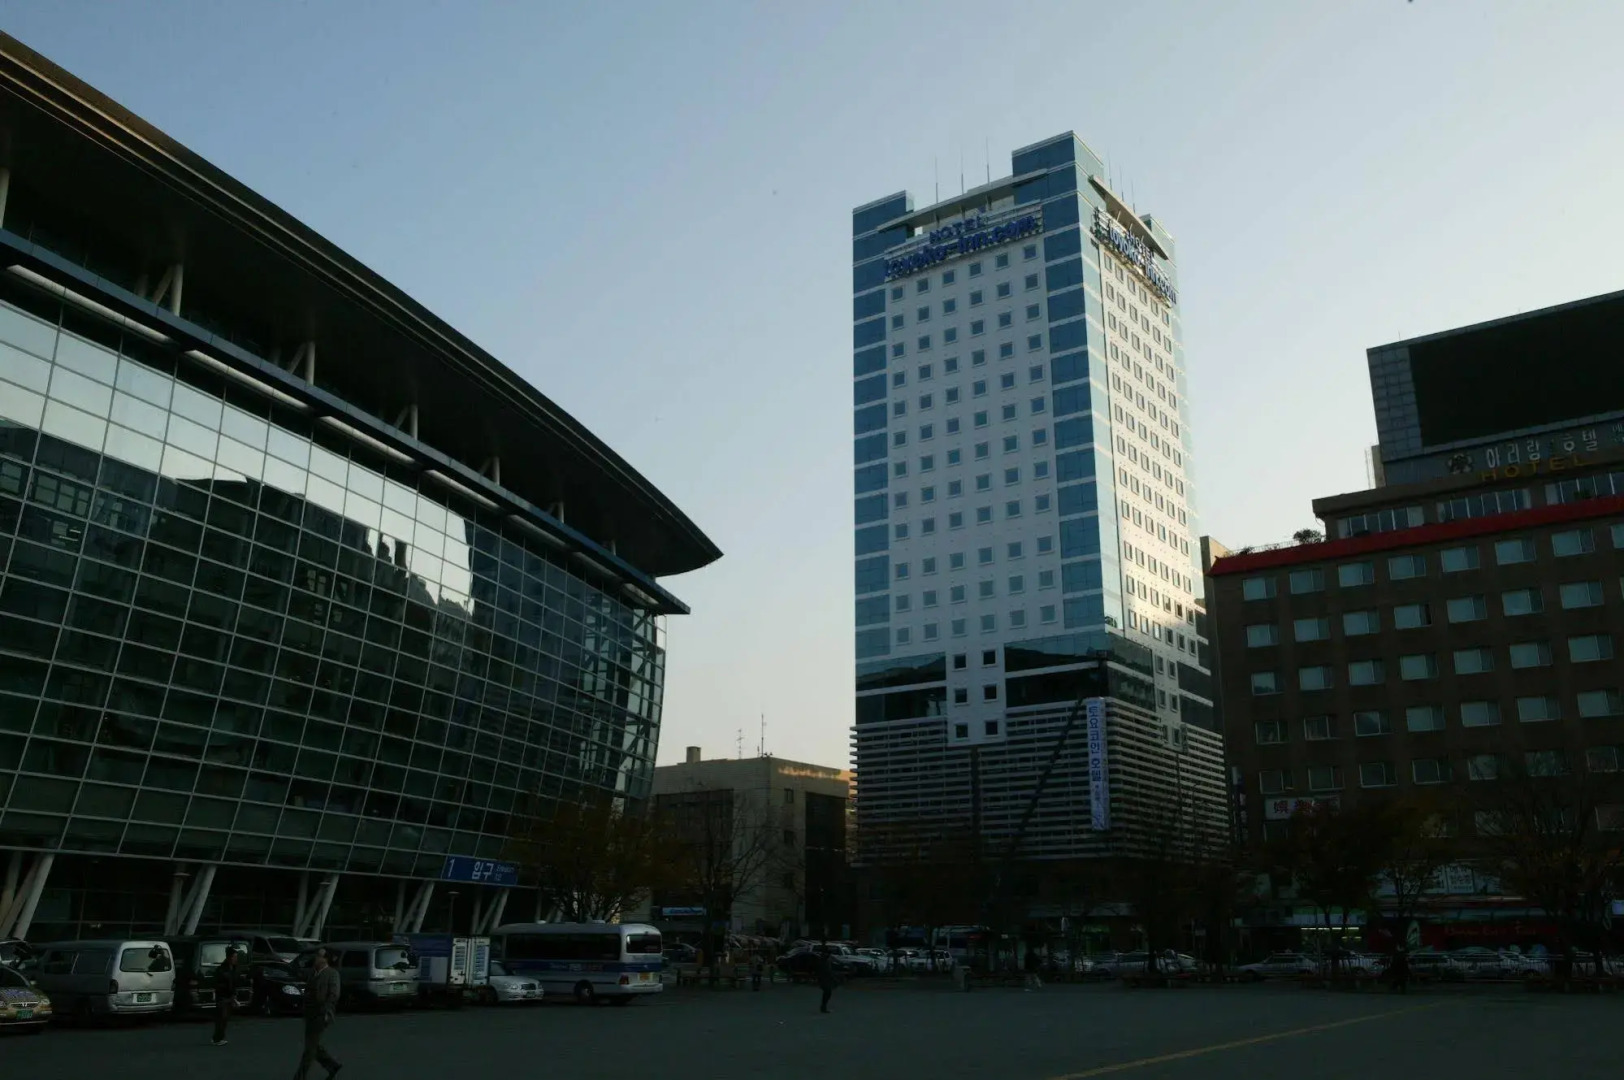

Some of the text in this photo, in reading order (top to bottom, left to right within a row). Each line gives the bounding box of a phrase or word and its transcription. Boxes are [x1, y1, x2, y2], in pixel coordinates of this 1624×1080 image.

[1486, 439, 1540, 468] 아리랑
[1563, 428, 1598, 453] 호텔
[1480, 454, 1592, 481] HOTEL
[447, 858, 456, 878] 1
[471, 861, 494, 880] 입구
